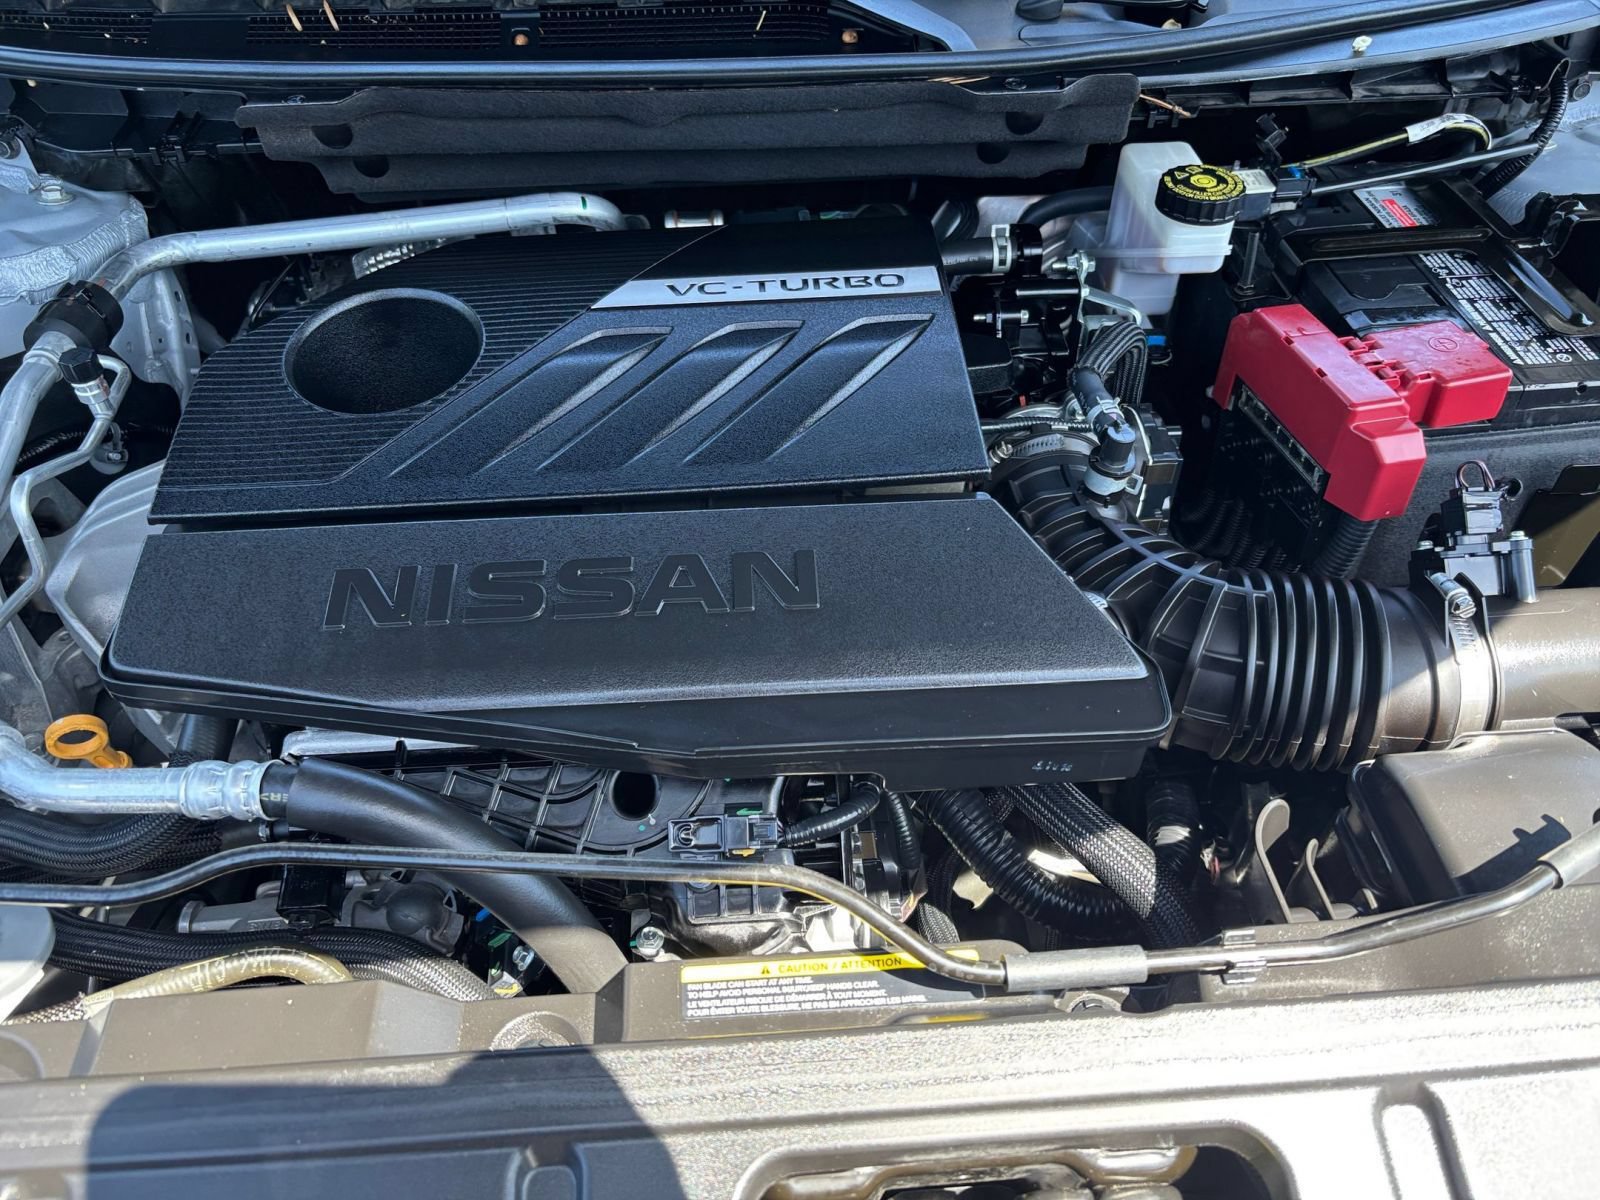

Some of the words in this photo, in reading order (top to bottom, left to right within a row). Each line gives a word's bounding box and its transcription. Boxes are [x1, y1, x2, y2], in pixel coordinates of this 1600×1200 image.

[664, 273, 905, 297] VC-TURBO
[321, 549, 821, 630] NISSAN
[778, 962, 829, 974] CAUTION
[841, 957, 903, 970] ATTENTION
[727, 980, 745, 989] CAN
[687, 991, 699, 1000] TO
[699, 989, 719, 999] HELP
[719, 988, 741, 998] AVOID
[687, 1000, 698, 1009] LE
[687, 1008, 710, 1017] POUR
